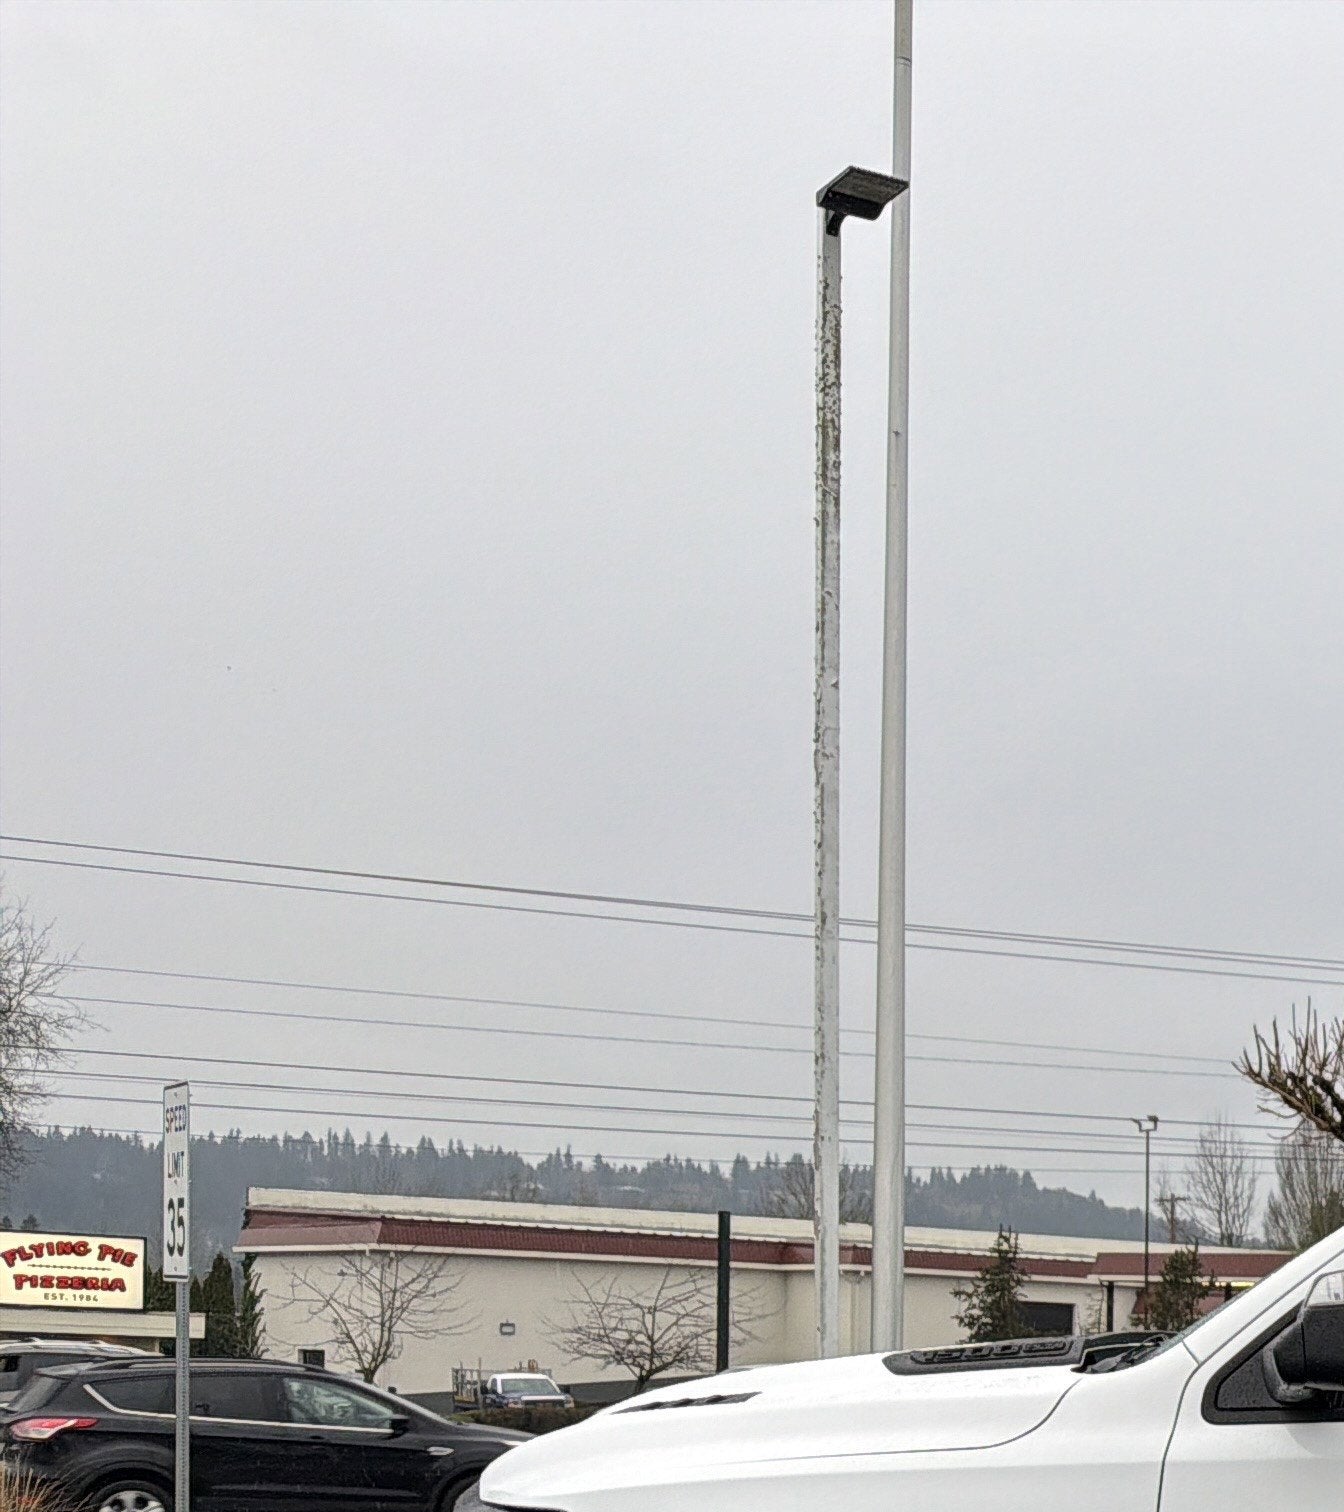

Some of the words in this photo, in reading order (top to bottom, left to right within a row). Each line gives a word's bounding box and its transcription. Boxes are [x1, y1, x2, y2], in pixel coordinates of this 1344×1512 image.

[165, 1104, 187, 1134] SPEED
[167, 1150, 185, 1179] LIMIT
[166, 1197, 186, 1258] 35
[1, 1241, 92, 1268] FLYING
[97, 1244, 138, 1267] PIE
[13, 1273, 127, 1292] PIZZERIA
[43, 1292, 69, 1302] EST.
[72, 1293, 99, 1302] 1984
